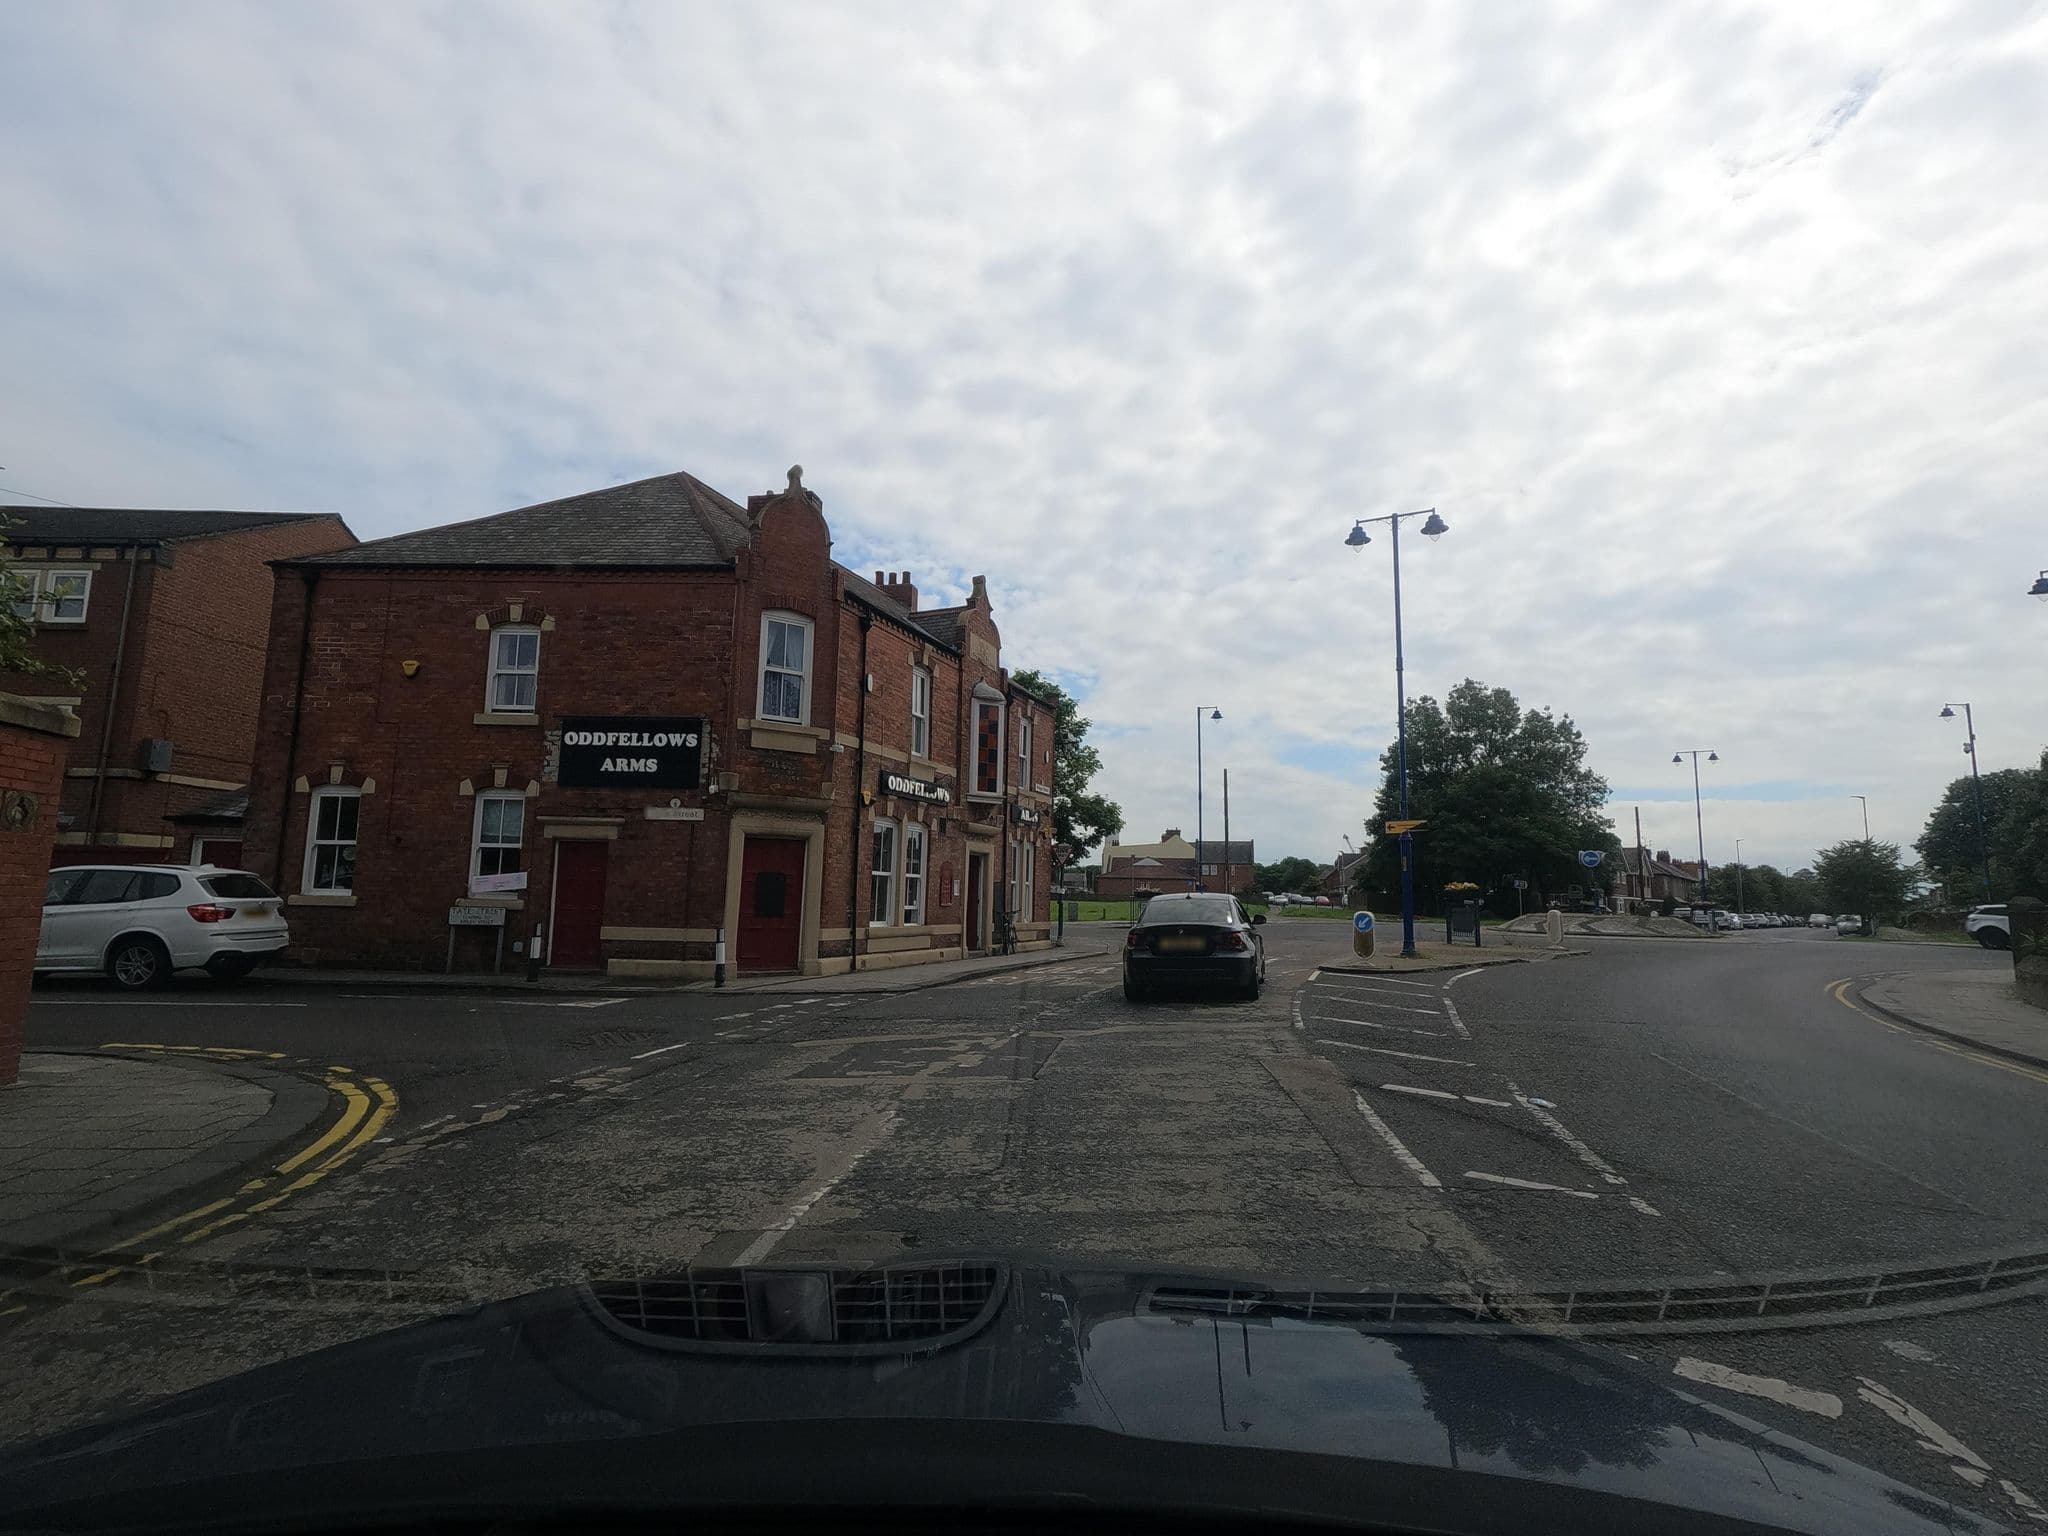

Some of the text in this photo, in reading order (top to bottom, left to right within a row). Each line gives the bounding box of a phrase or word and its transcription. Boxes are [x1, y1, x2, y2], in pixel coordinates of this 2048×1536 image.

[564, 732, 698, 747] ODDFELLOWS
[600, 758, 658, 772] ARMS
[888, 775, 950, 802] ODDFELWS
[1020, 809, 1039, 823] ARS
